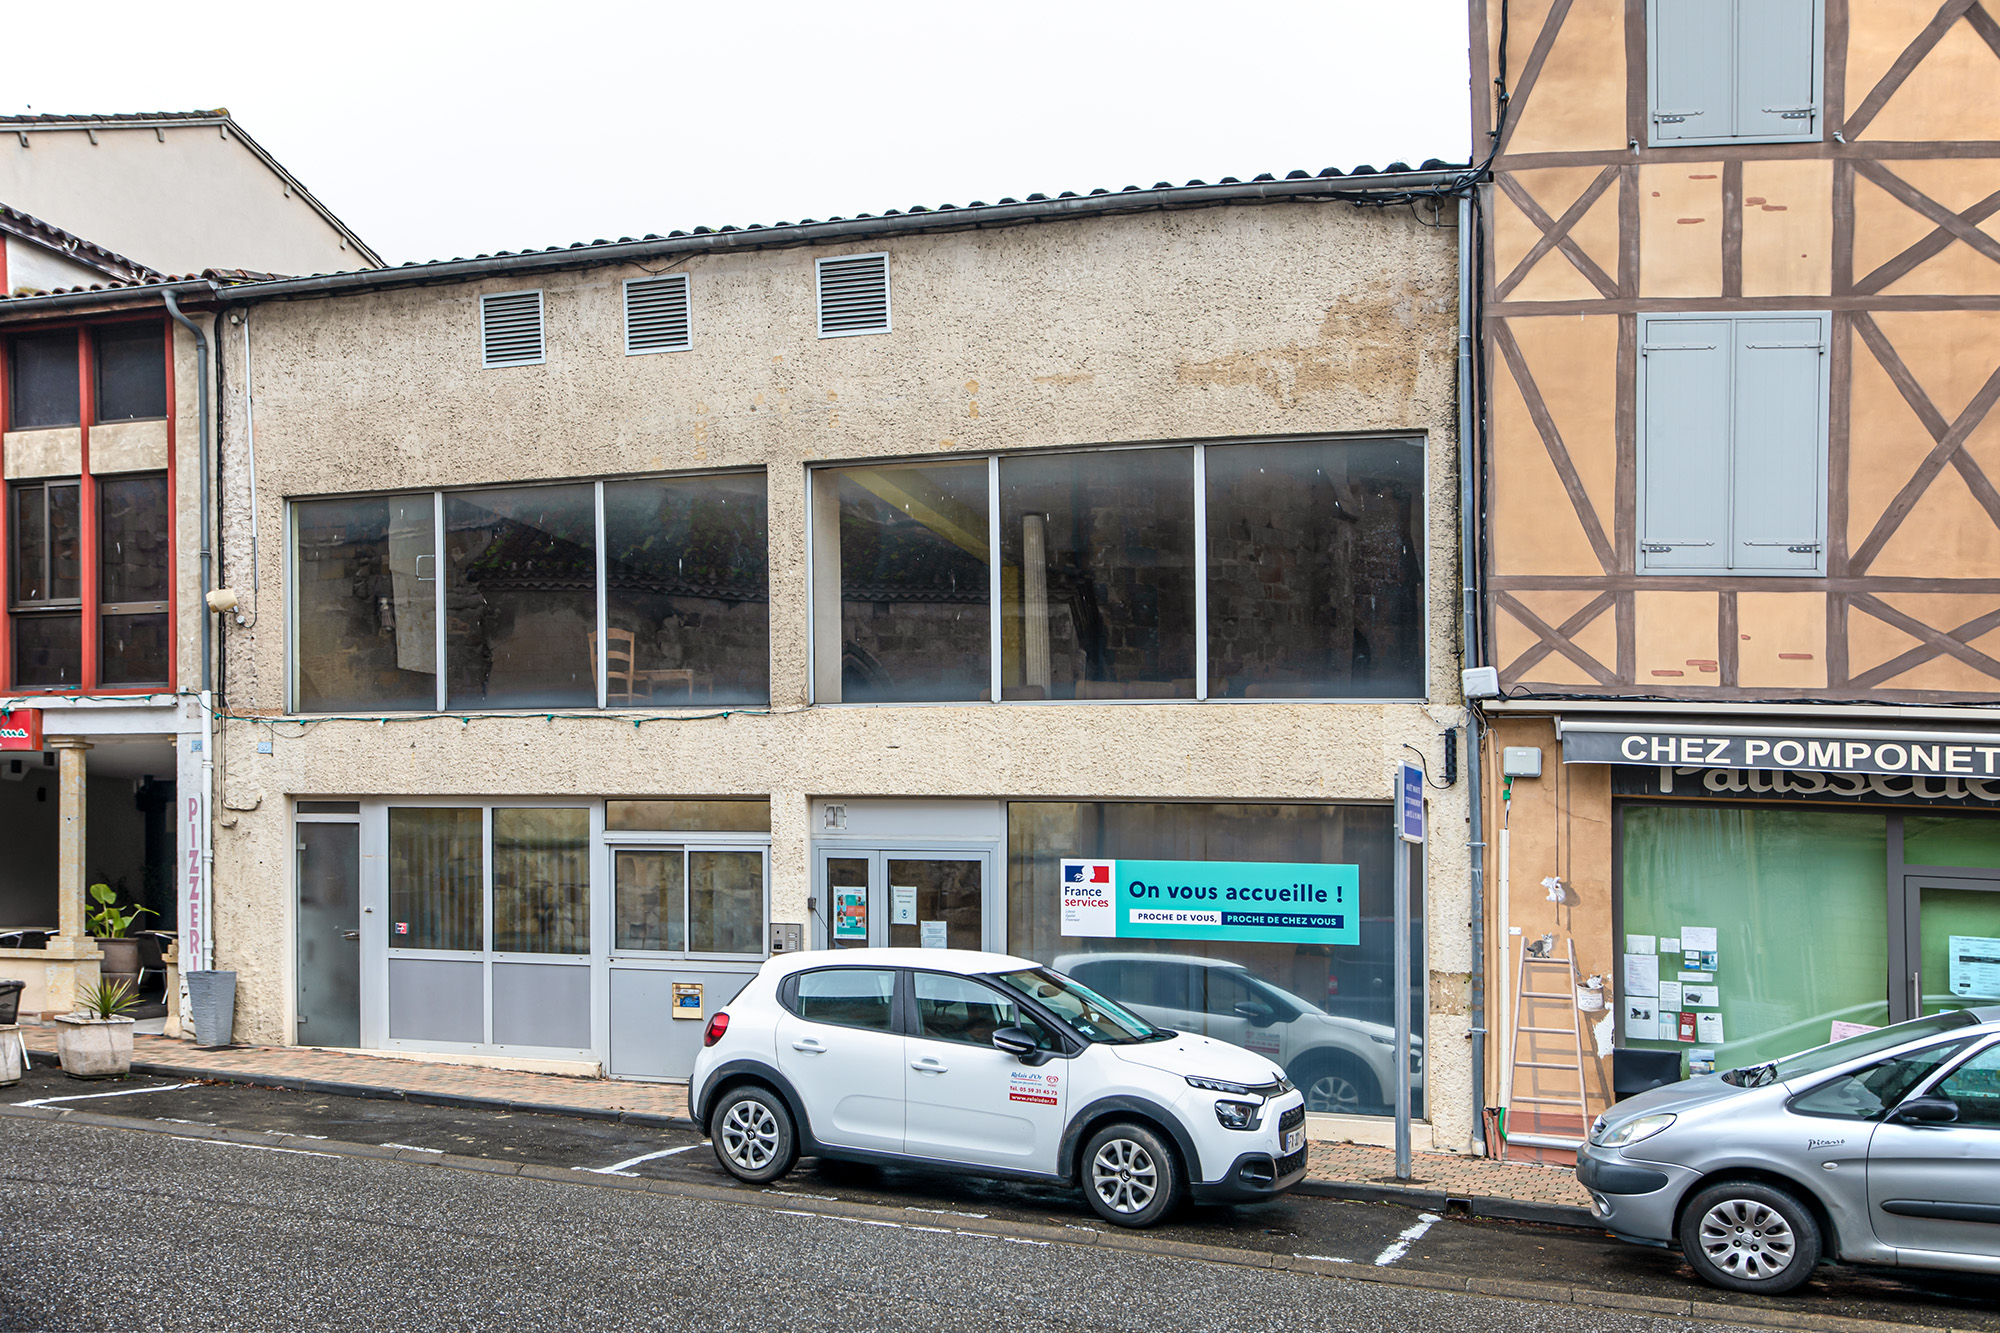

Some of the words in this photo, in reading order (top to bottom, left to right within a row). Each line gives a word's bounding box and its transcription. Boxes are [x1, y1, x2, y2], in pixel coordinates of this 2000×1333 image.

[1621, 736, 1731, 764] CHEZ
[1745, 740, 2000, 774] POMPONET
[1064, 886, 1102, 897] France
[1129, 881, 1160, 899] On
[1167, 885, 1218, 900] vous
[1226, 884, 1328, 903] accueille
[1336, 886, 1343, 903] !
[1064, 897, 1109, 908] services
[1138, 912, 1174, 921] PROCHE
[1176, 913, 1188, 922] DE
[1190, 914, 1218, 924] VOUS,
[1227, 915, 1265, 924] PROCHE
[1267, 916, 1280, 925] DE
[1282, 916, 1308, 926] CHEZ
[1310, 917, 1337, 926] VOUS
